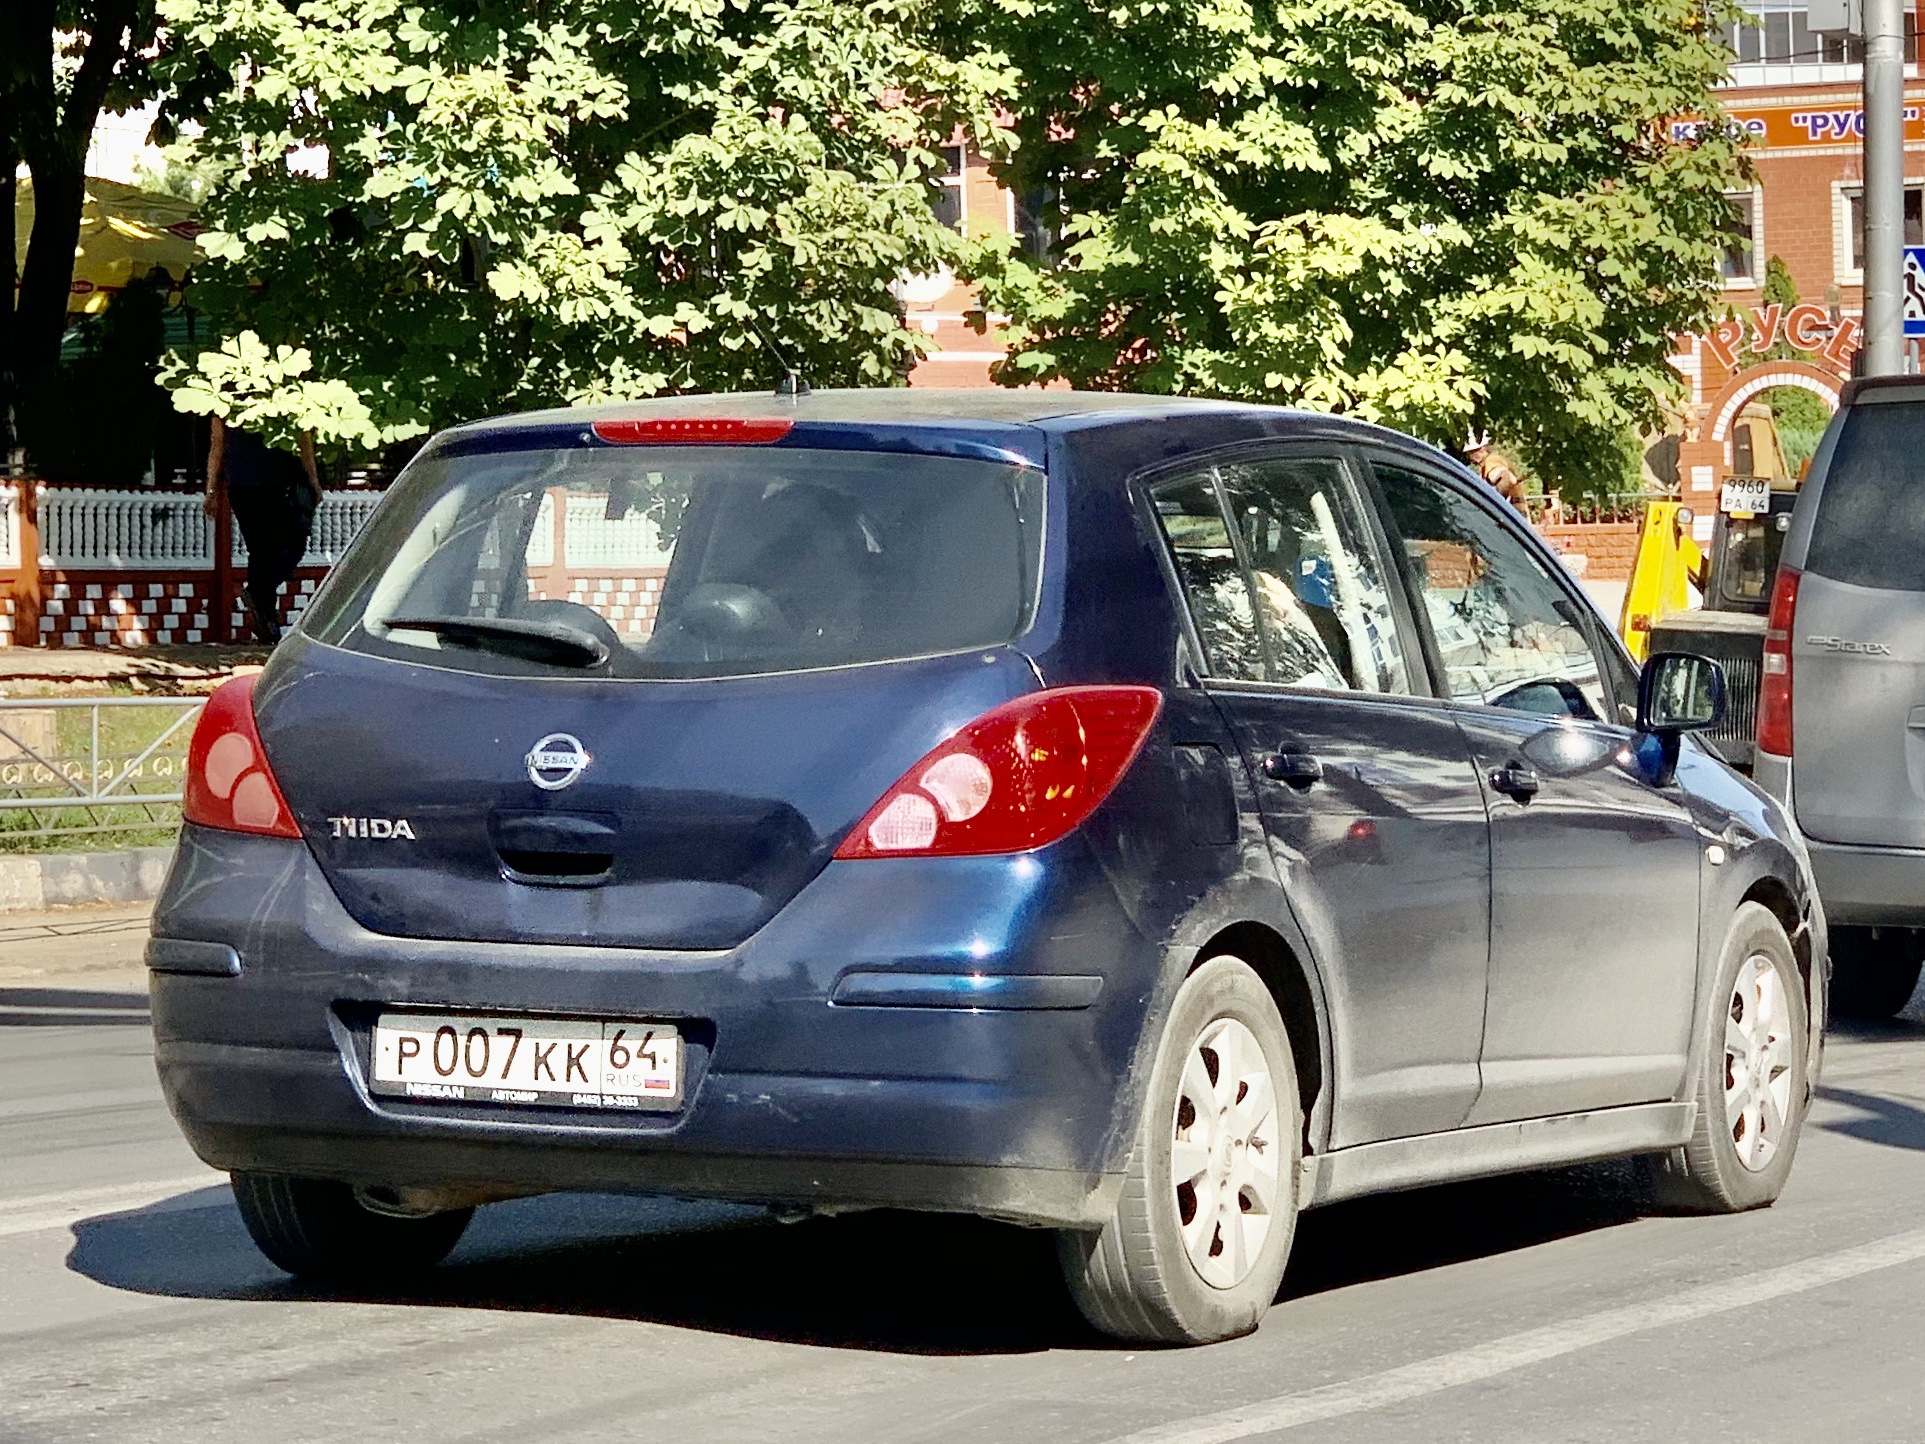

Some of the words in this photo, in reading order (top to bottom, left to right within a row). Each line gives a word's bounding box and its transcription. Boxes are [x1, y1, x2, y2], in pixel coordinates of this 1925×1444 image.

[1728, 479, 1764, 494] 9960
[1750, 499, 1765, 510] 64
[527, 754, 578, 765] NISSAN
[327, 817, 416, 840] TIIDA
[609, 1029, 657, 1071] 64
[606, 1073, 642, 1088] RUS
[405, 1082, 465, 1099] NISSAN
